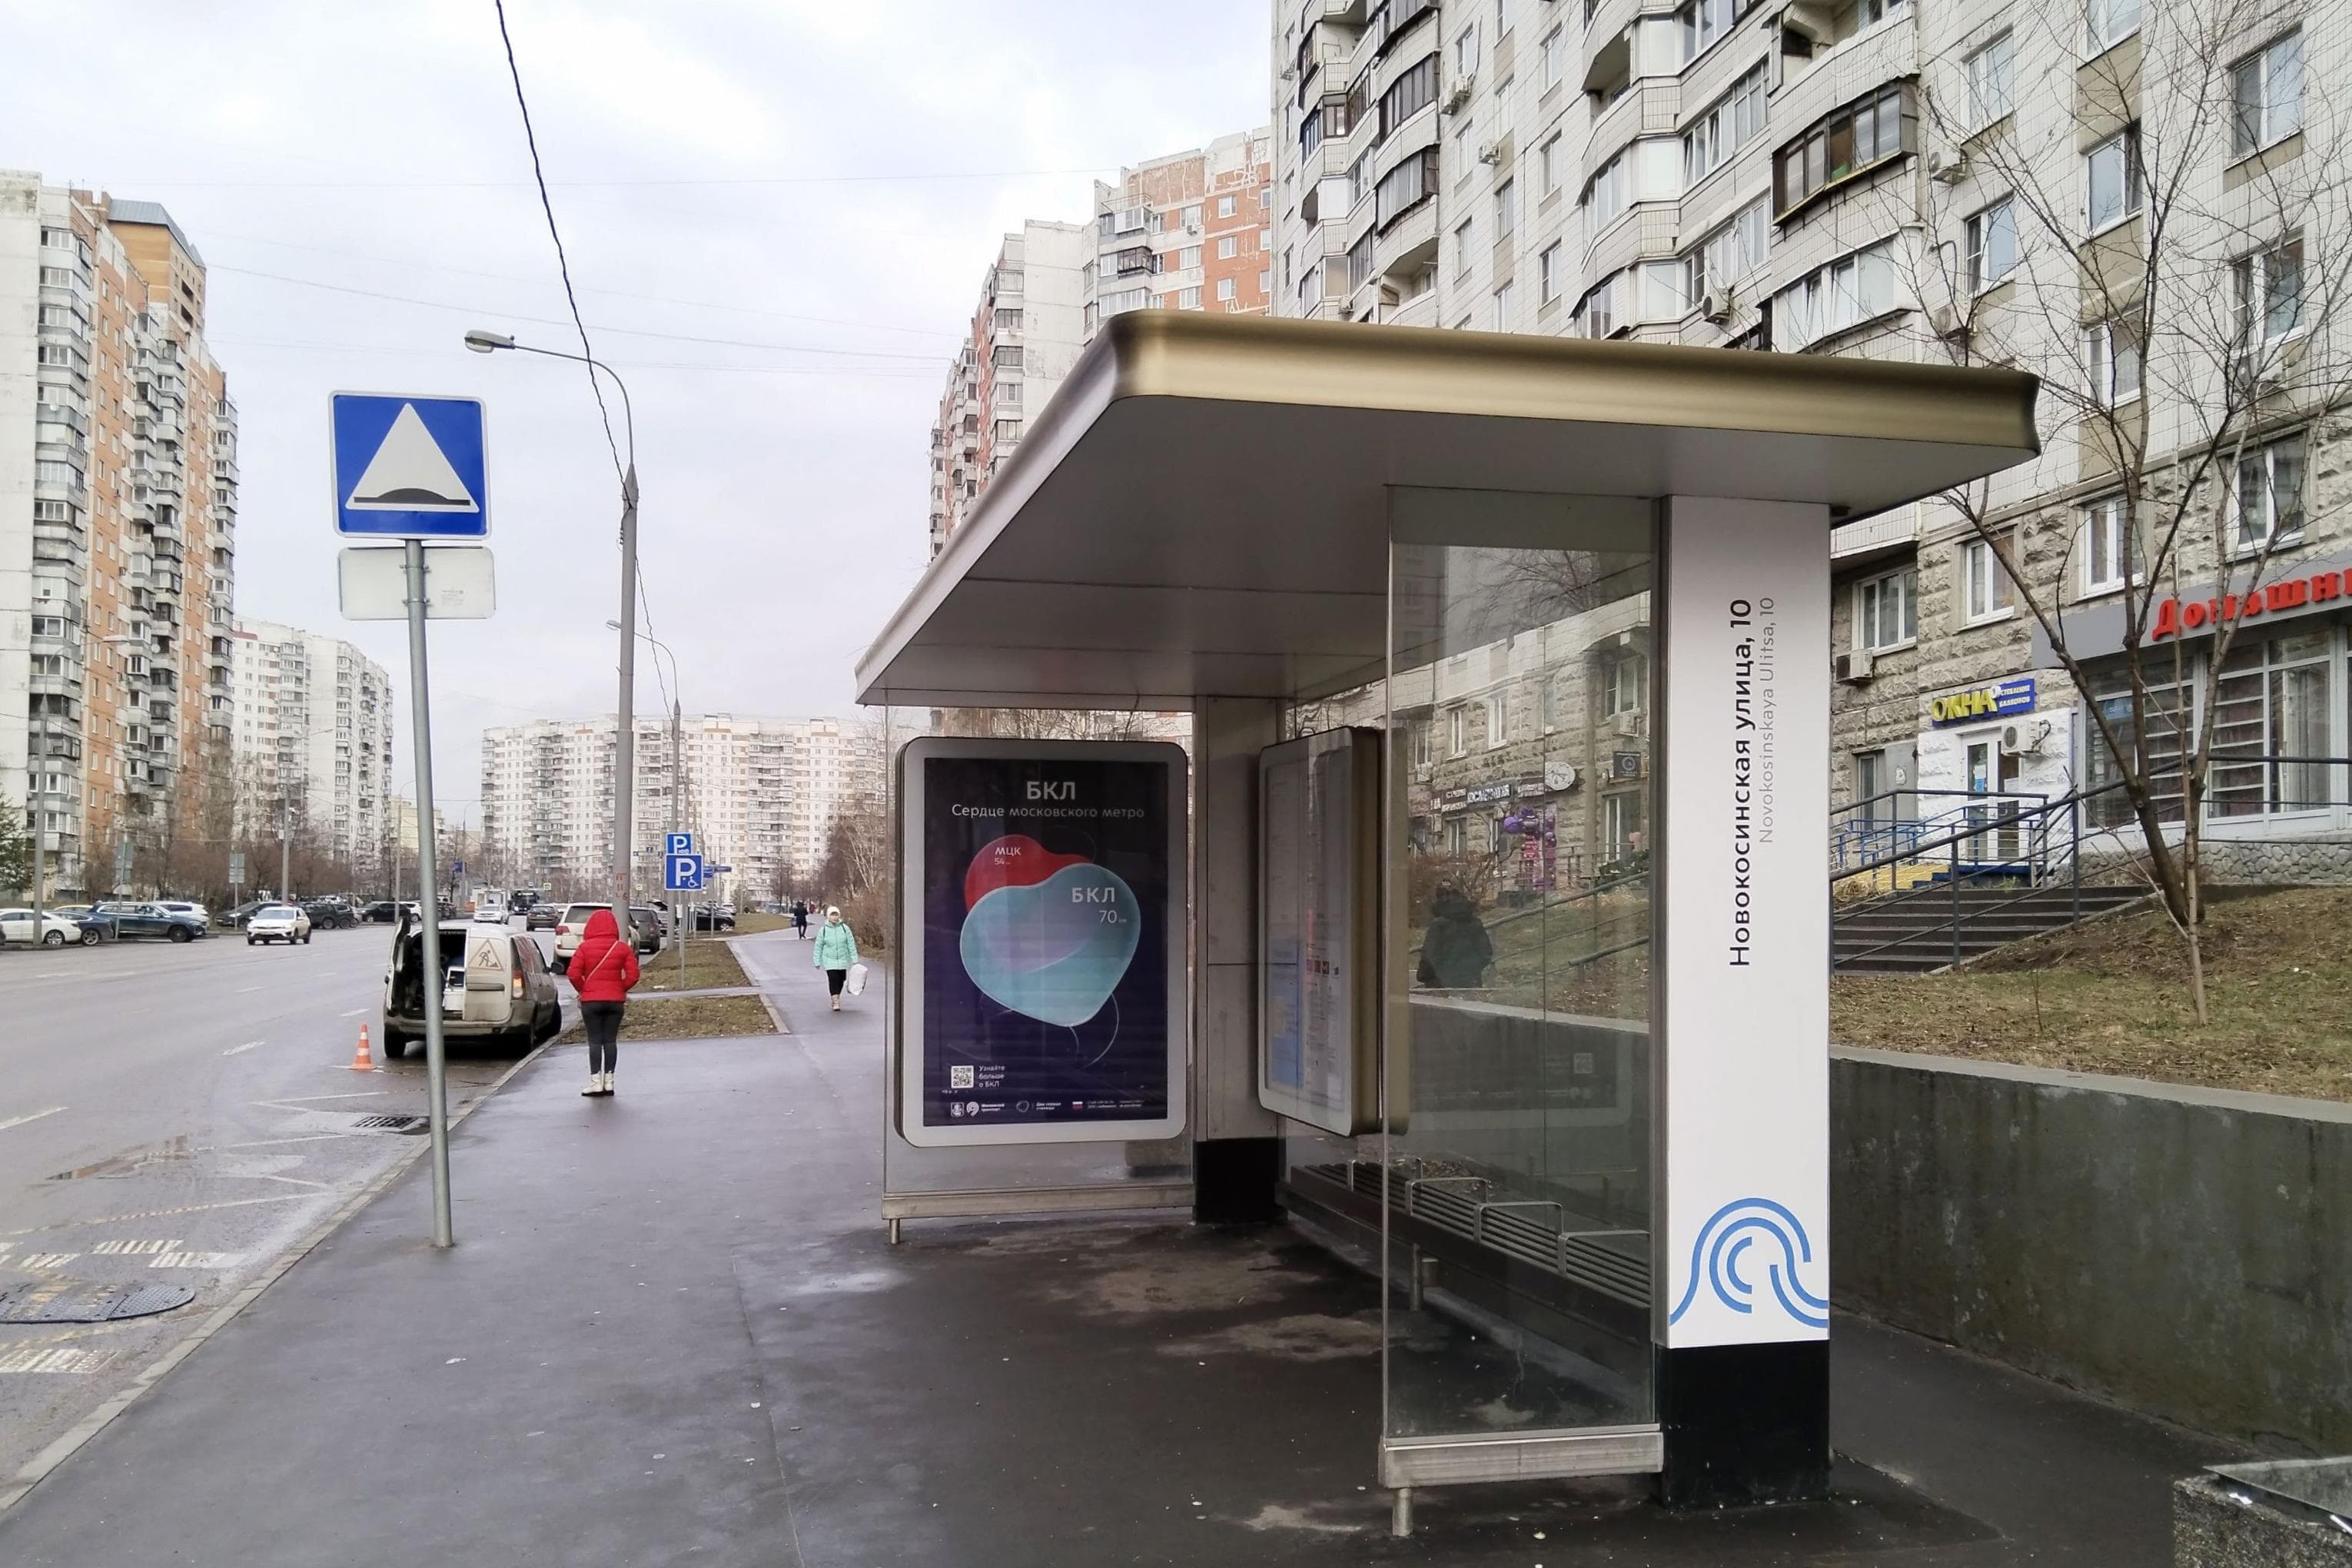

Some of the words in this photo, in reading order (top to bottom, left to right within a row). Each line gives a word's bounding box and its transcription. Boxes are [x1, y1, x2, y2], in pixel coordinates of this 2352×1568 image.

[1730, 600, 1751, 628] 10
[1760, 597, 1774, 616] 10
[1759, 623, 1776, 681] Ulitsa,
[1736, 637, 1756, 731] улица,
[1932, 688, 1998, 721] ОКНА
[1759, 689, 1777, 842] Novokosinskaya
[1026, 781, 1075, 800] БКЛ
[952, 804, 1004, 818] Сердце
[1009, 806, 1098, 818] московского
[1102, 808, 1144, 819] метро
[995, 847, 1021, 856] МЦК
[1729, 739, 1750, 965] Новокосинская
[1071, 887, 1115, 903] БКЛ
[1099, 909, 1118, 923] 70
